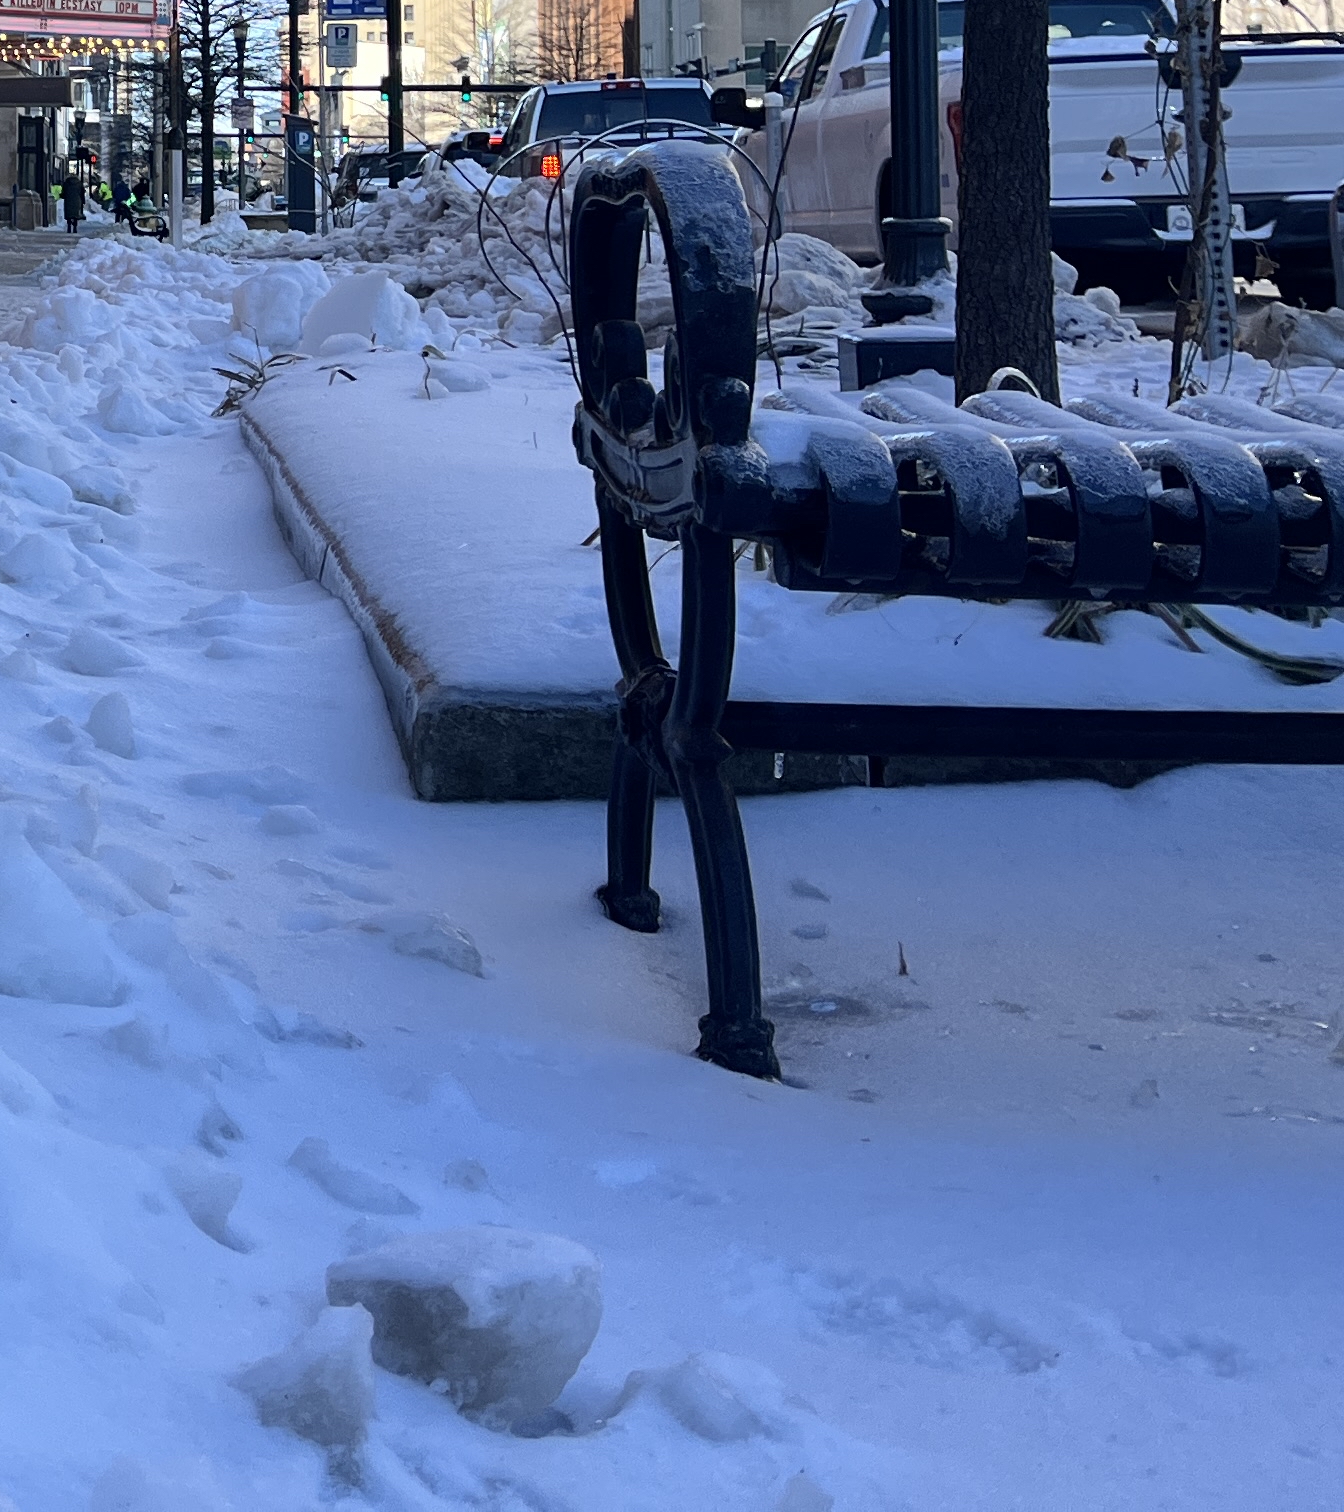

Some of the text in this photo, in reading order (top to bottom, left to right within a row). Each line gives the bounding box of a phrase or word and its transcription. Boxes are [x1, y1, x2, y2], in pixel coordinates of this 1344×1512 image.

[61, 0, 102, 12] ECSTASY
[115, 2, 139, 14] 10PM
[338, 28, 347, 39] P
[298, 132, 309, 145] P
